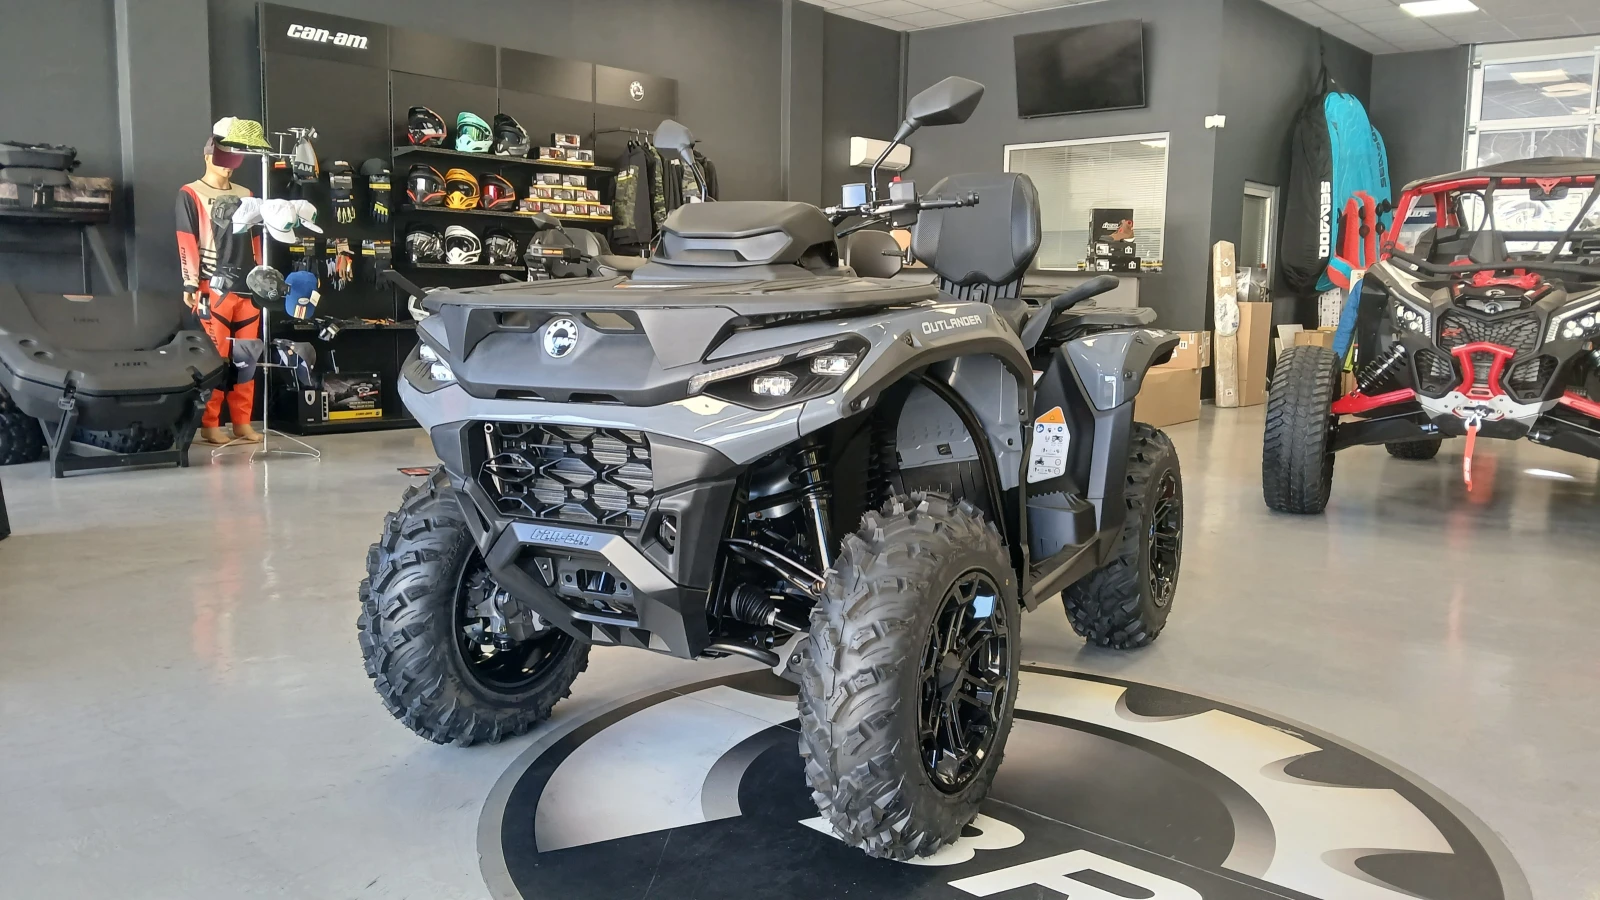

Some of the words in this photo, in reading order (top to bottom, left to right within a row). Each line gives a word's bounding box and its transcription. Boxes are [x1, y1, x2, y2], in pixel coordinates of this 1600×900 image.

[287, 23, 368, 49] can-am
[921, 314, 983, 335] OUTLANDER
[530, 528, 594, 546] can-am
